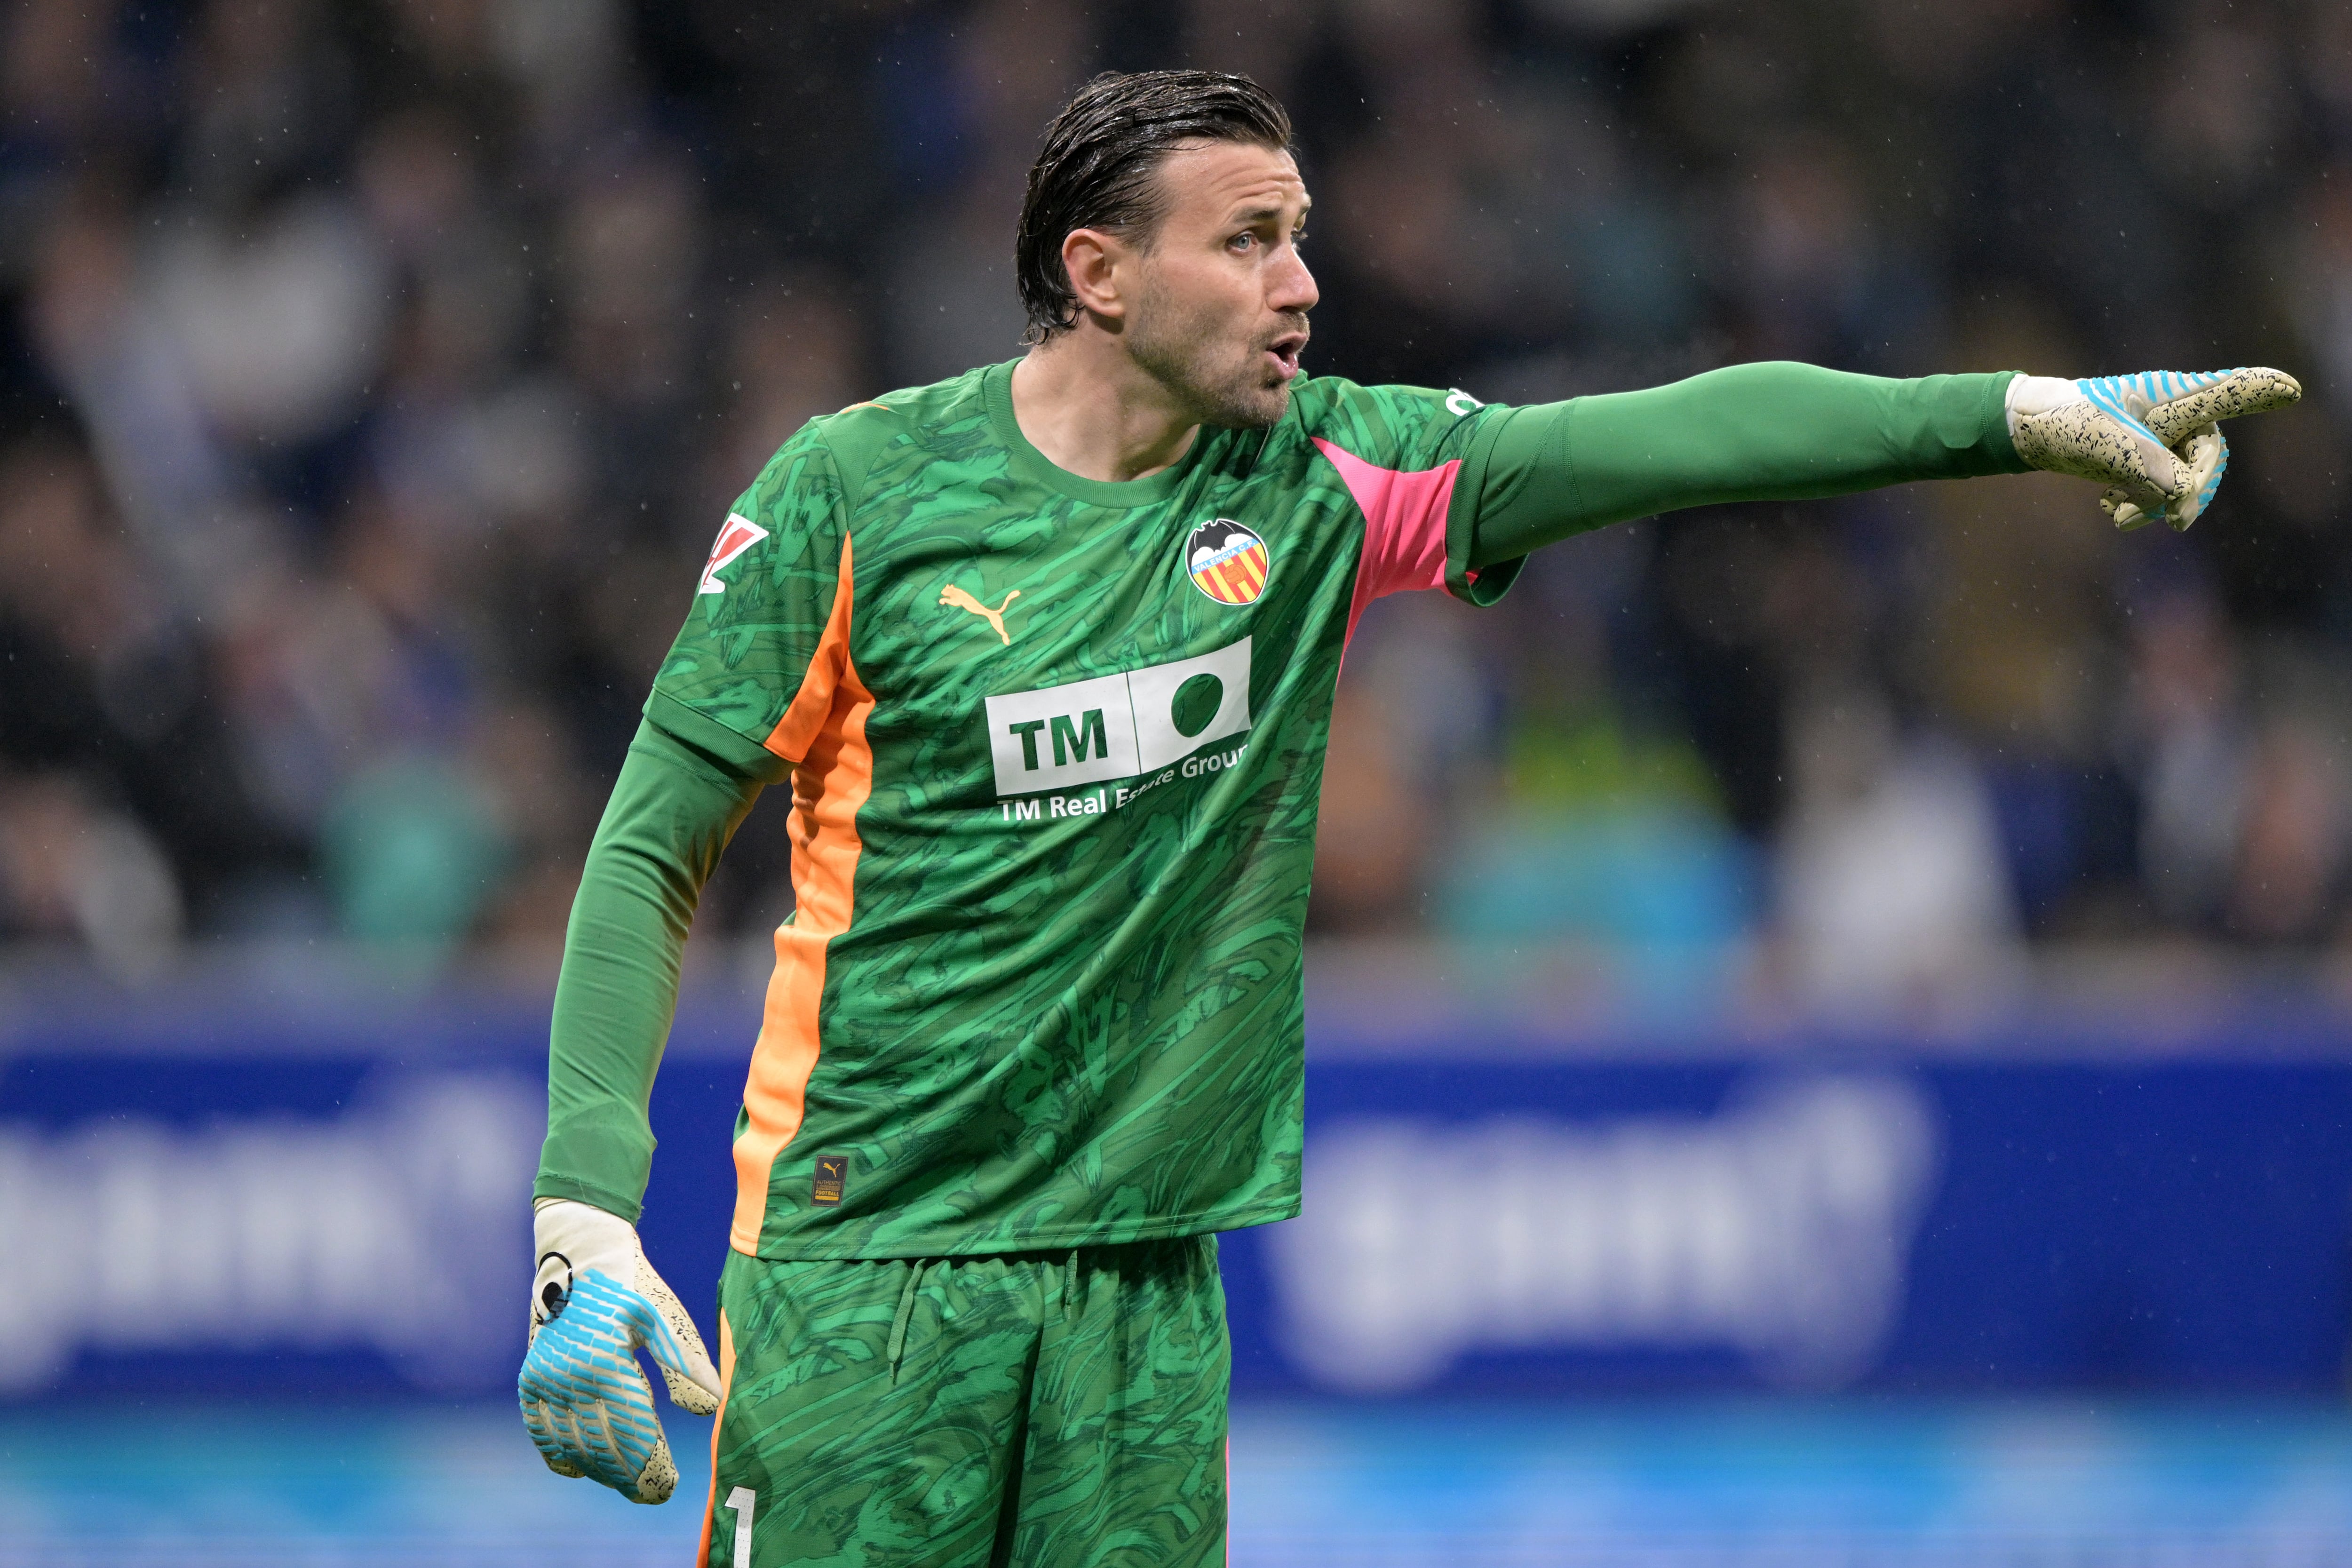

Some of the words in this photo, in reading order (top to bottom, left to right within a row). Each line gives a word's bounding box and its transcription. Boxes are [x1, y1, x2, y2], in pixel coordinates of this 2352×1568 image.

[1195, 549, 1238, 572] VALENCIA
[1239, 540, 1256, 551] C.F.
[1009, 708, 1108, 772] TM
[997, 798, 1041, 821] TM
[1049, 789, 1106, 818] Real
[1115, 769, 1175, 810] Estate
[724, 1485, 756, 1568] 1
